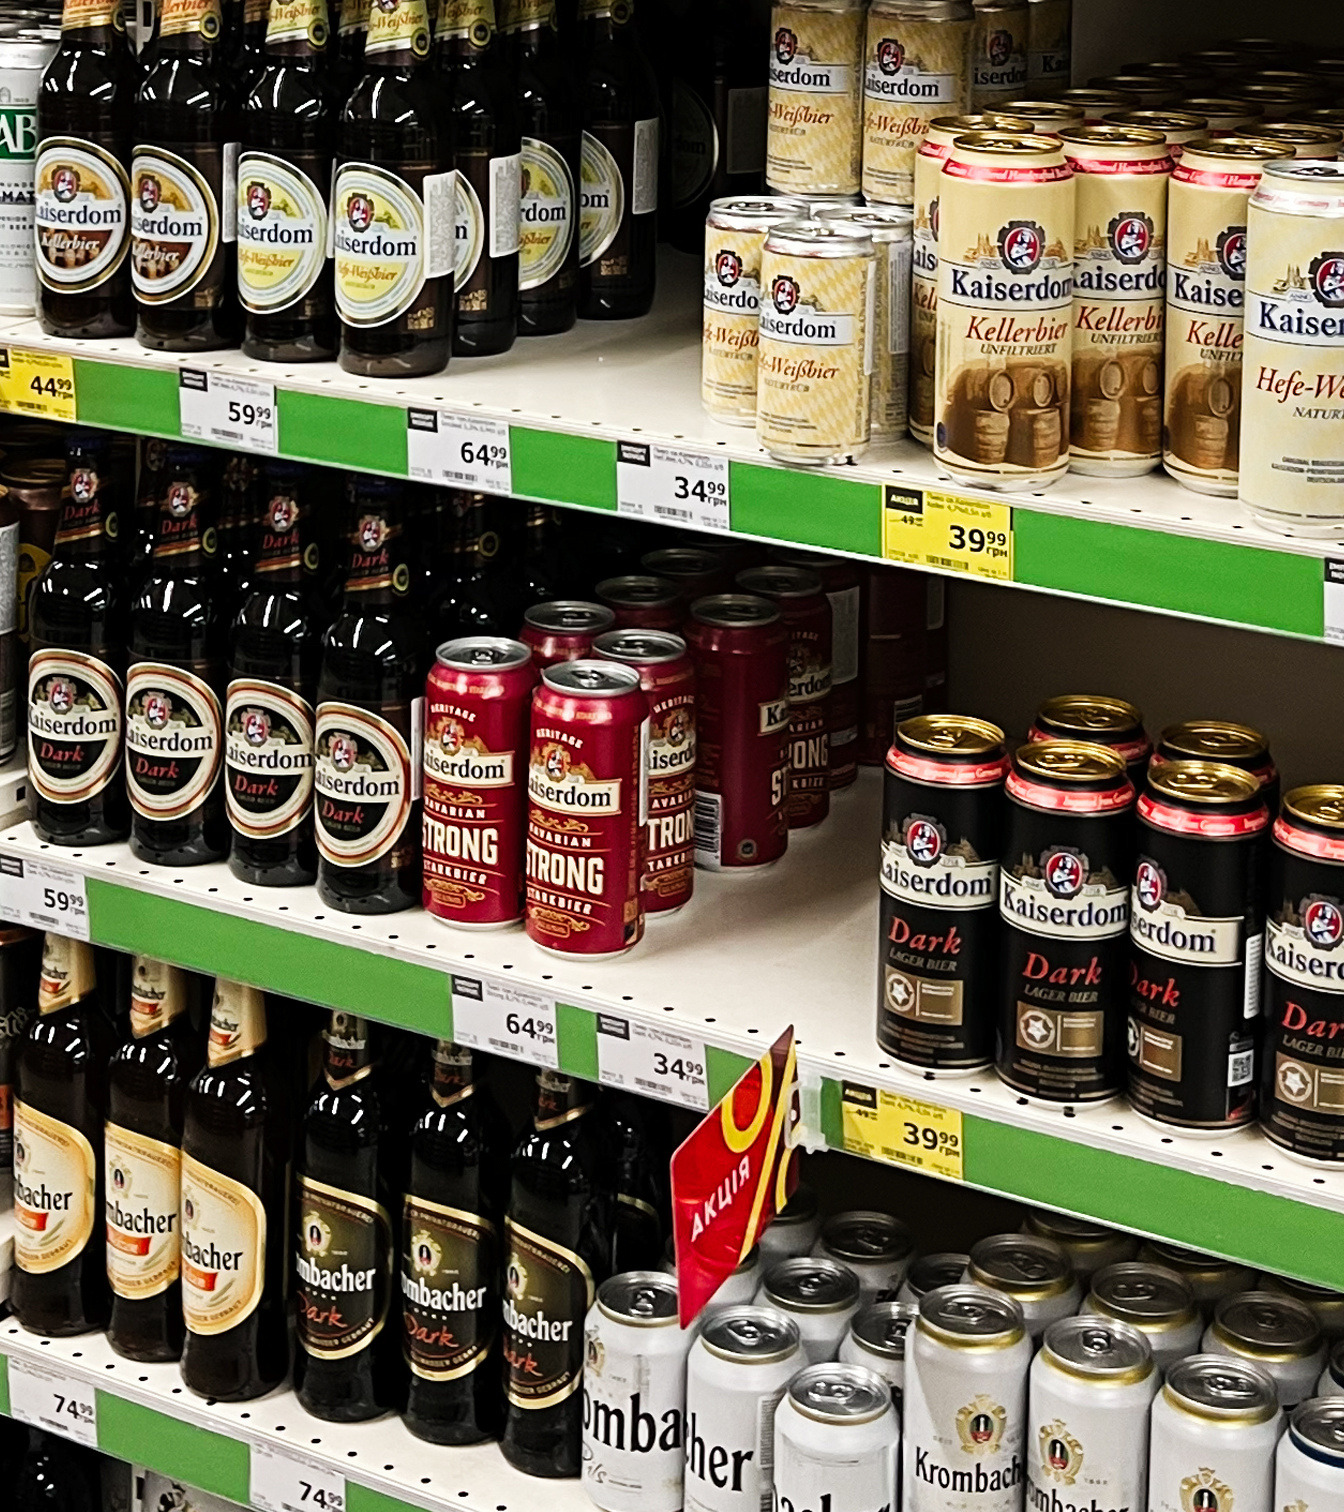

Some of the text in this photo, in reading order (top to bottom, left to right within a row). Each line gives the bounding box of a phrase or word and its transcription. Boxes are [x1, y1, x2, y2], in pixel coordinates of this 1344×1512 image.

[965, 315, 1067, 341] Kellerbier
[979, 342, 1057, 356] UNFILTRIERT
[228, 401, 254, 425] 59
[460, 441, 490, 467] 64
[674, 476, 706, 503] 34
[948, 524, 1006, 552] 39 99
[40, 743, 84, 766] Dark
[135, 758, 179, 780] Dark
[235, 774, 278, 797] Dark
[43, 887, 68, 909] 59
[887, 915, 962, 954] Dark
[1021, 952, 1103, 986] Dark
[505, 1013, 537, 1039] 64
[652, 1054, 685, 1080] 34
[902, 1122, 959, 1148] 39 99
[690, 1155, 751, 1243] АКЦІЯ
[54, 1394, 78, 1420] 74
